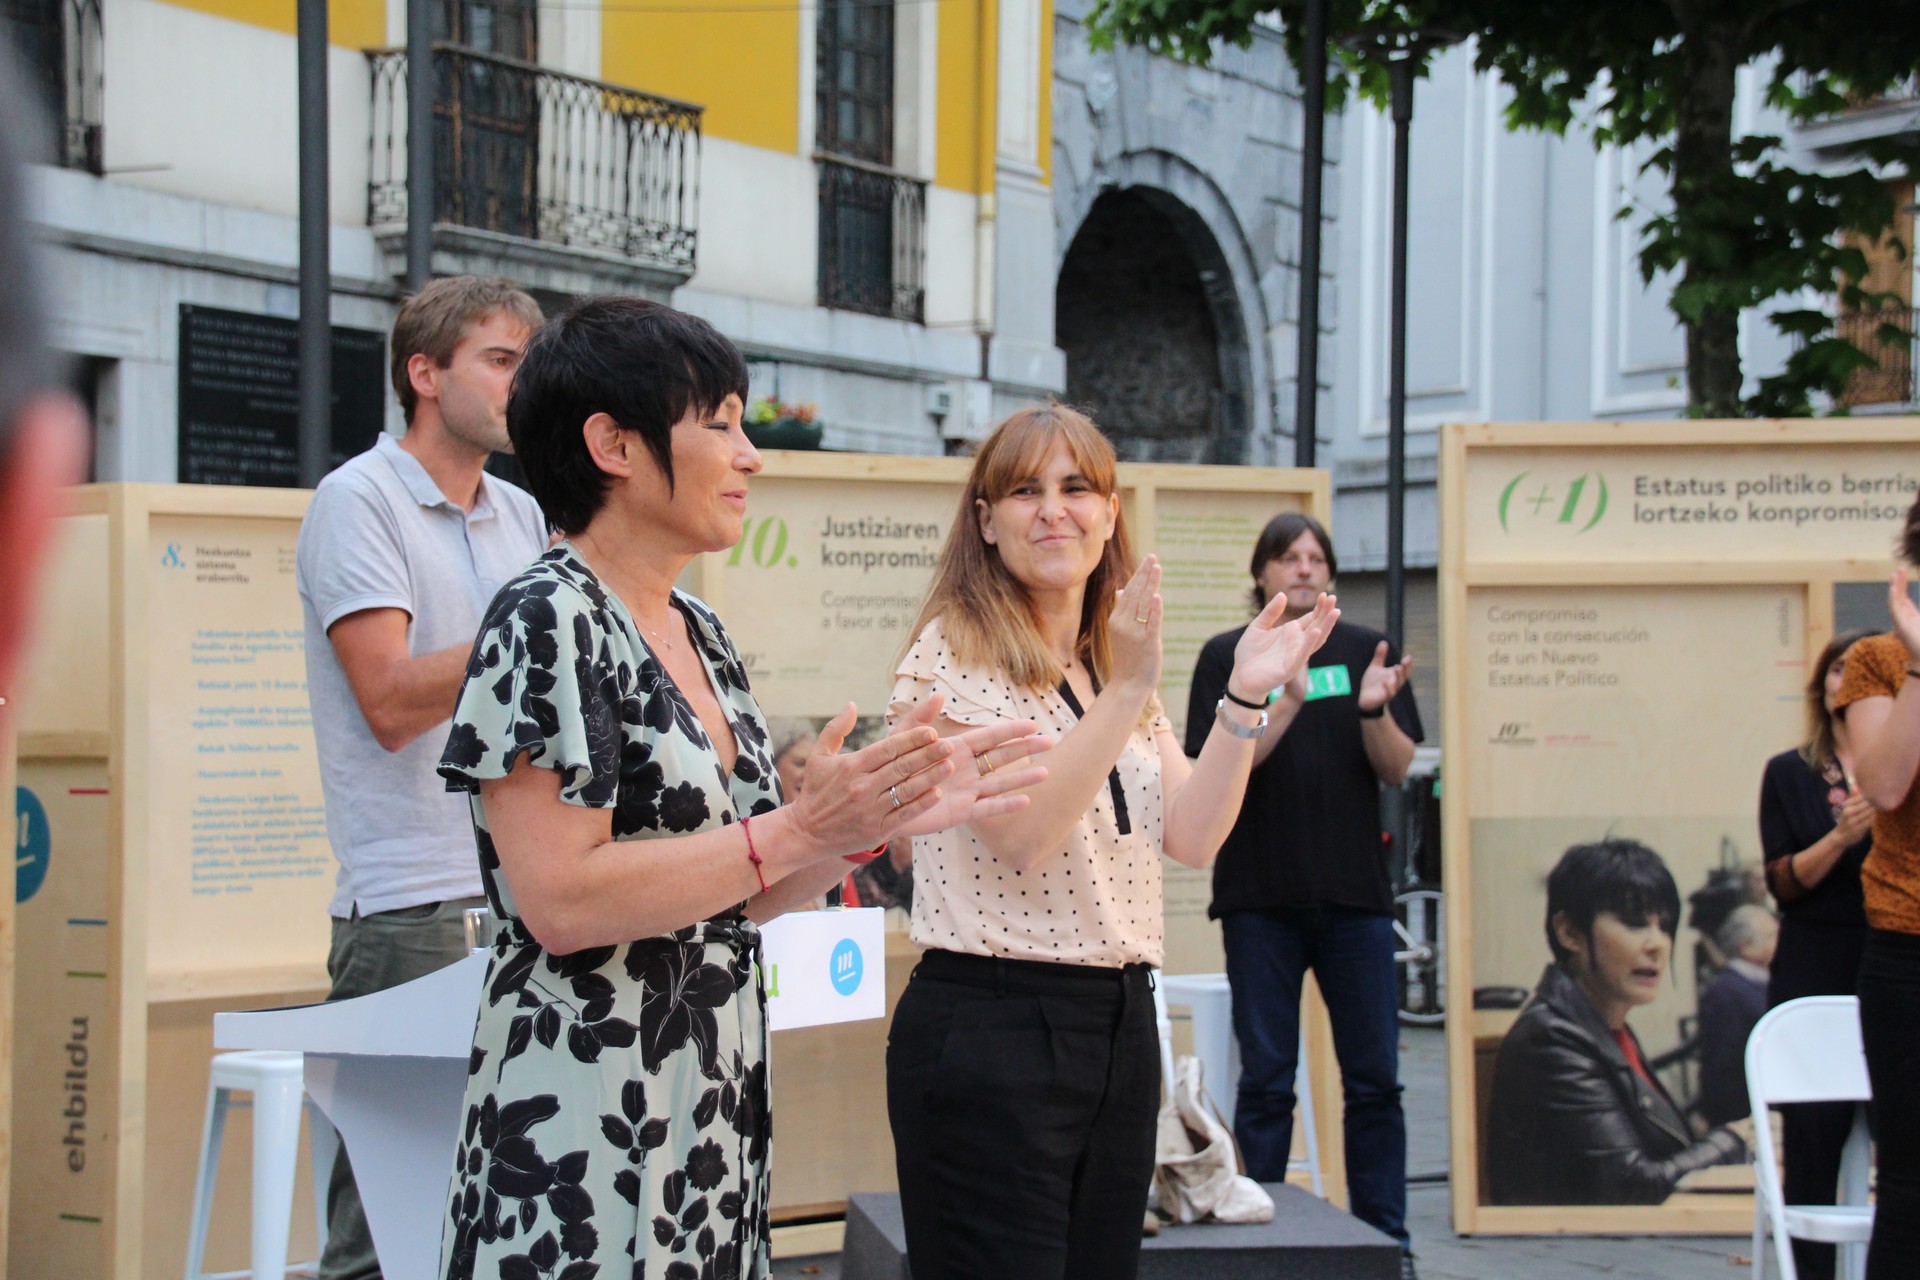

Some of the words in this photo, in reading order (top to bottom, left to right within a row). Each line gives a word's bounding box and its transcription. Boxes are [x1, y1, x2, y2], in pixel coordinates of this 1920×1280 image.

[1634, 475, 1726, 496] Estatus
[1737, 473, 1832, 504] politiko
[1634, 503, 1737, 523] lortzeko
[1748, 500, 1908, 528] konpromiso
[820, 514, 939, 539] Justiziaren
[820, 543, 940, 573] konpromis
[834, 612, 873, 628] favor
[878, 613, 898, 628] de
[1486, 606, 1598, 628] Compromiso
[1487, 629, 1519, 644] con
[1523, 627, 1539, 644] la
[1543, 624, 1650, 644] consecución
[1487, 649, 1510, 666] de
[1515, 652, 1537, 666] un
[1542, 650, 1598, 666] Nuevo
[1487, 670, 1550, 687] Estatus
[1555, 668, 1619, 688] Político
[63, 1015, 90, 1173] ehbildu
